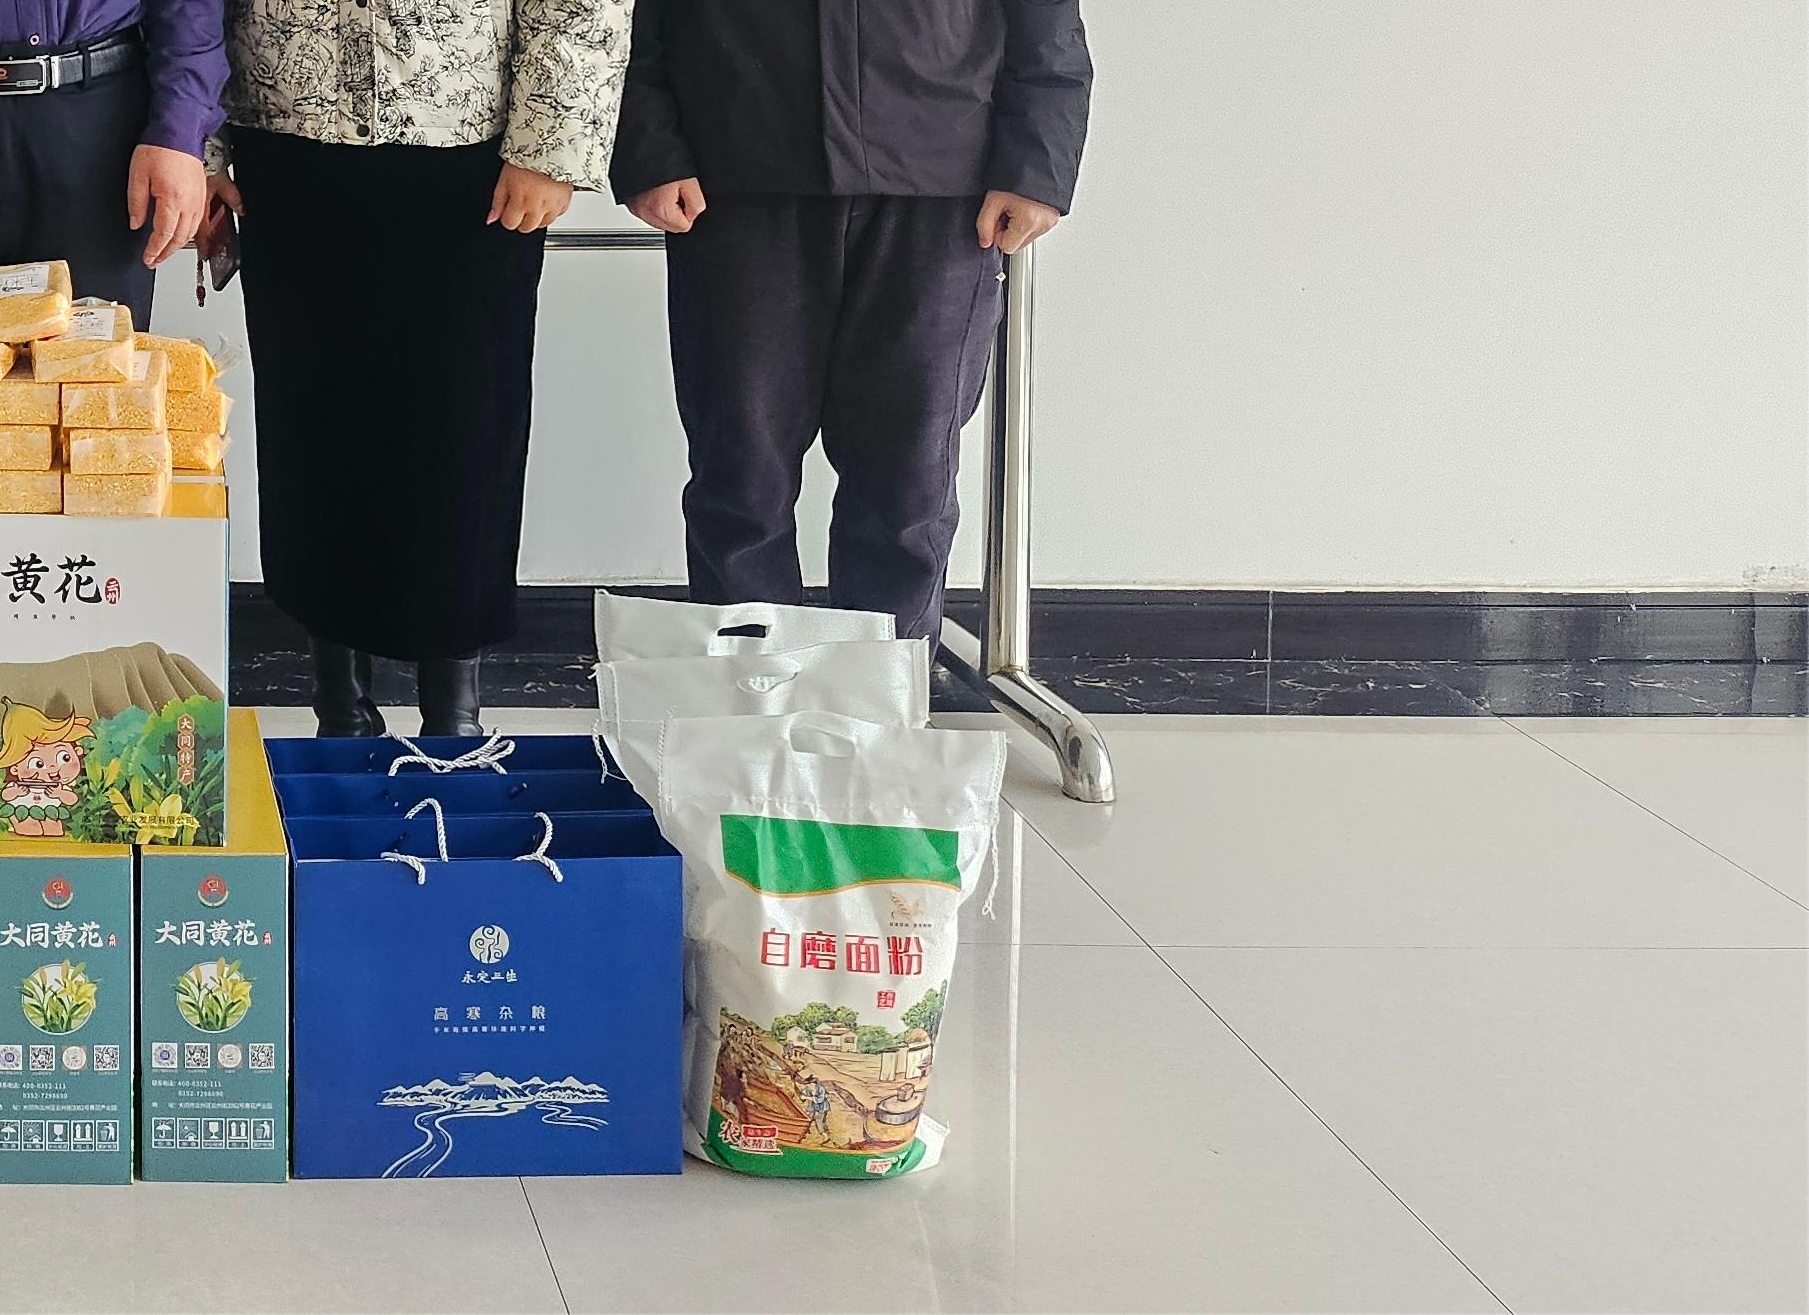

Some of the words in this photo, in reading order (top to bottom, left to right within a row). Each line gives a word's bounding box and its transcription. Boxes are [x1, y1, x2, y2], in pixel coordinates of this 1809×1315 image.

[180, 717, 193, 781] 大同特产
[0, 920, 104, 949] 大同黄花
[154, 918, 259, 947] 大同黄花
[760, 927, 925, 976] 自磨面粉
[433, 1005, 547, 1021] 高寒杂粮
